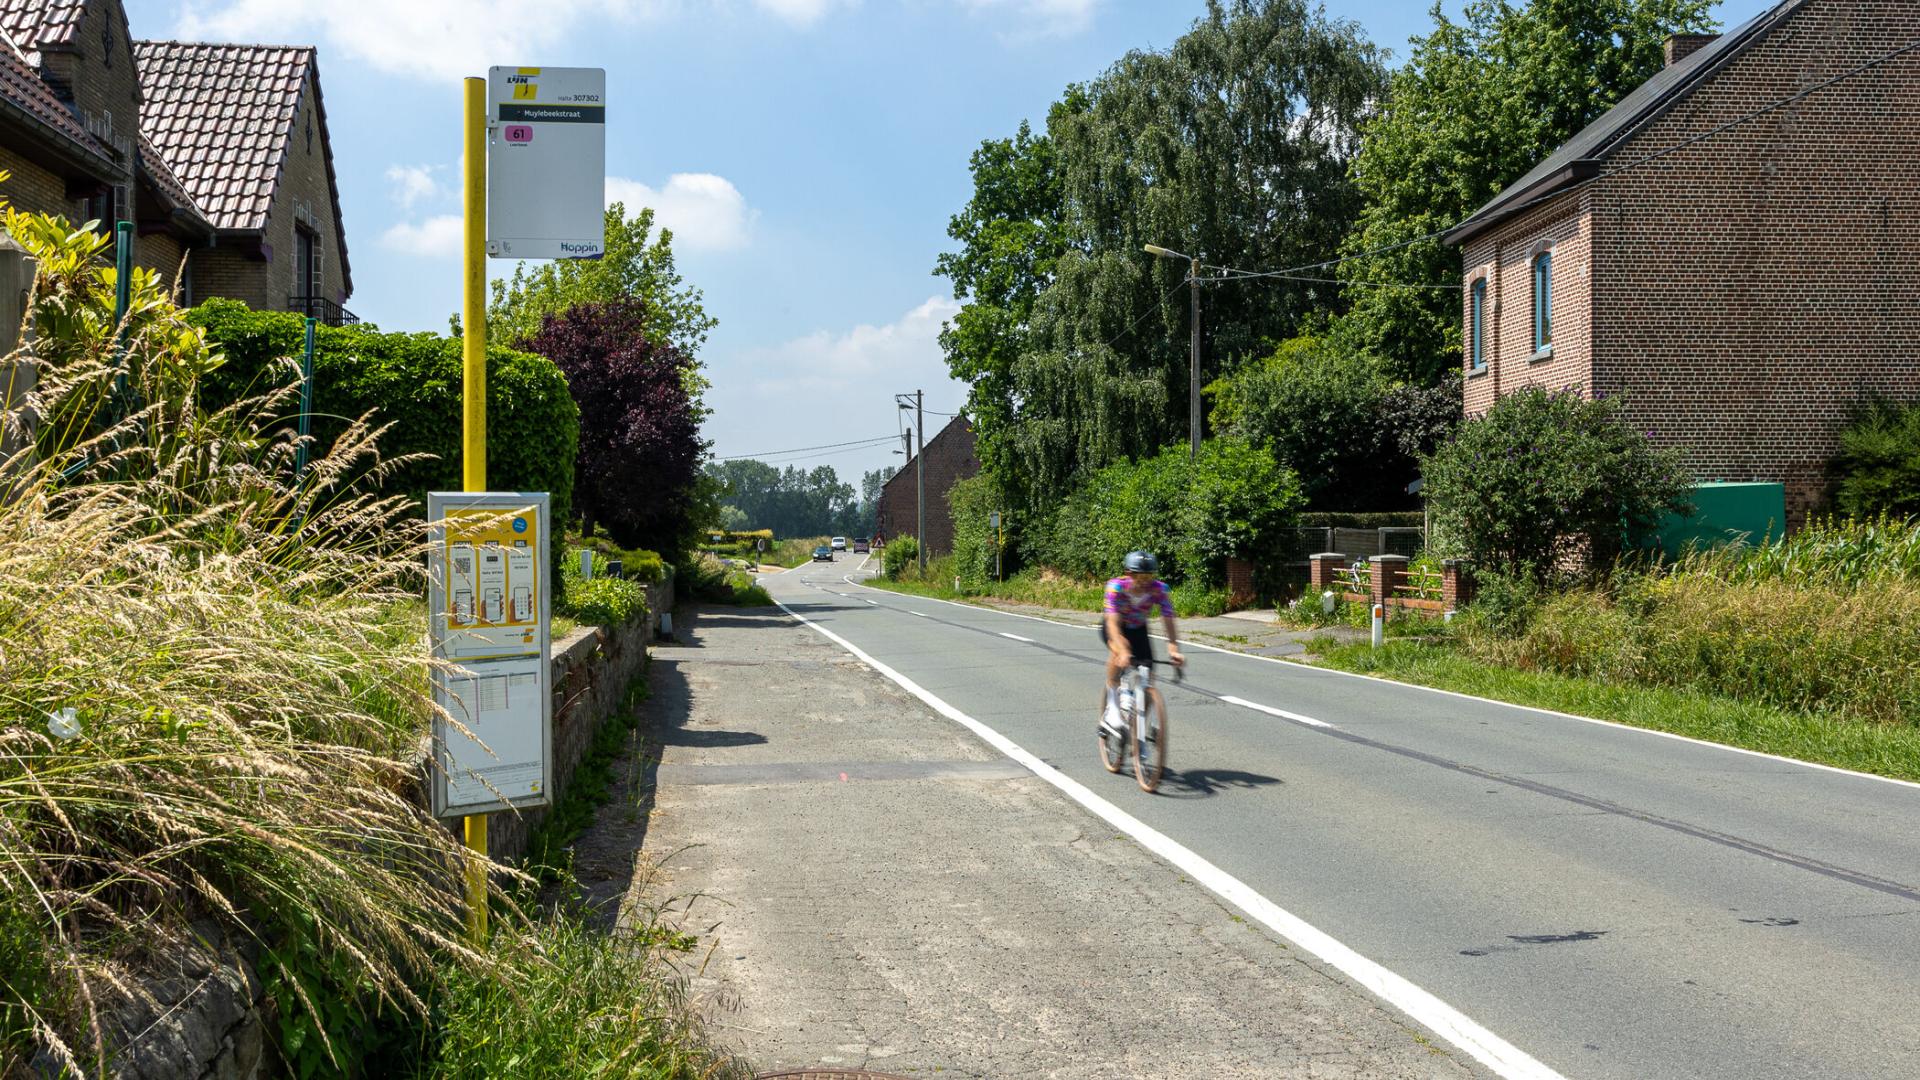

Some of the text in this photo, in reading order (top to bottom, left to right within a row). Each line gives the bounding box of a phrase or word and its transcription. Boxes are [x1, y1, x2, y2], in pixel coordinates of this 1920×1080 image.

[524, 110, 581, 118] Muylebeekstraat
[513, 129, 524, 139] 61
[561, 242, 598, 253] Hoppin
